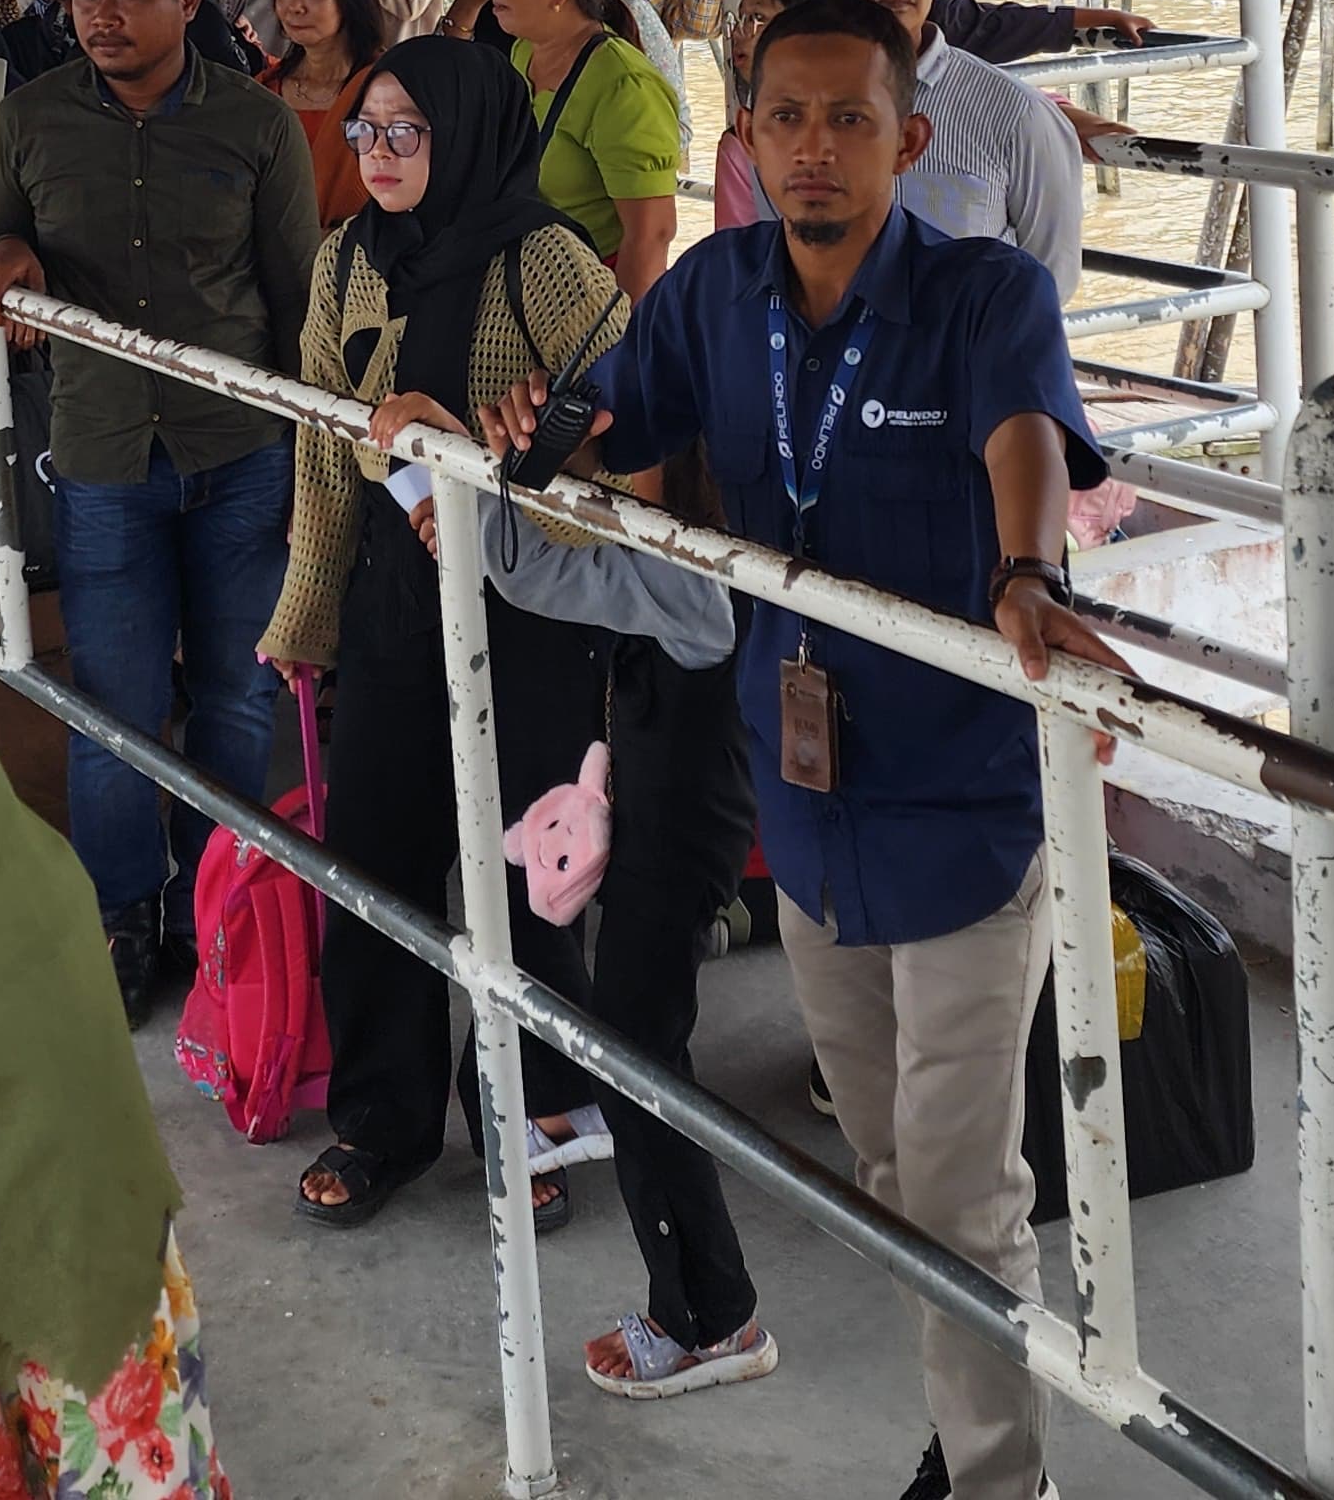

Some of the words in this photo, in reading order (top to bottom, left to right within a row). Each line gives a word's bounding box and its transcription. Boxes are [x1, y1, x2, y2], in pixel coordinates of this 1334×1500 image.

[773, 371, 788, 440] PELINDO
[810, 403, 838, 471] PELINDO
[886, 409, 942, 421] PELINDO
